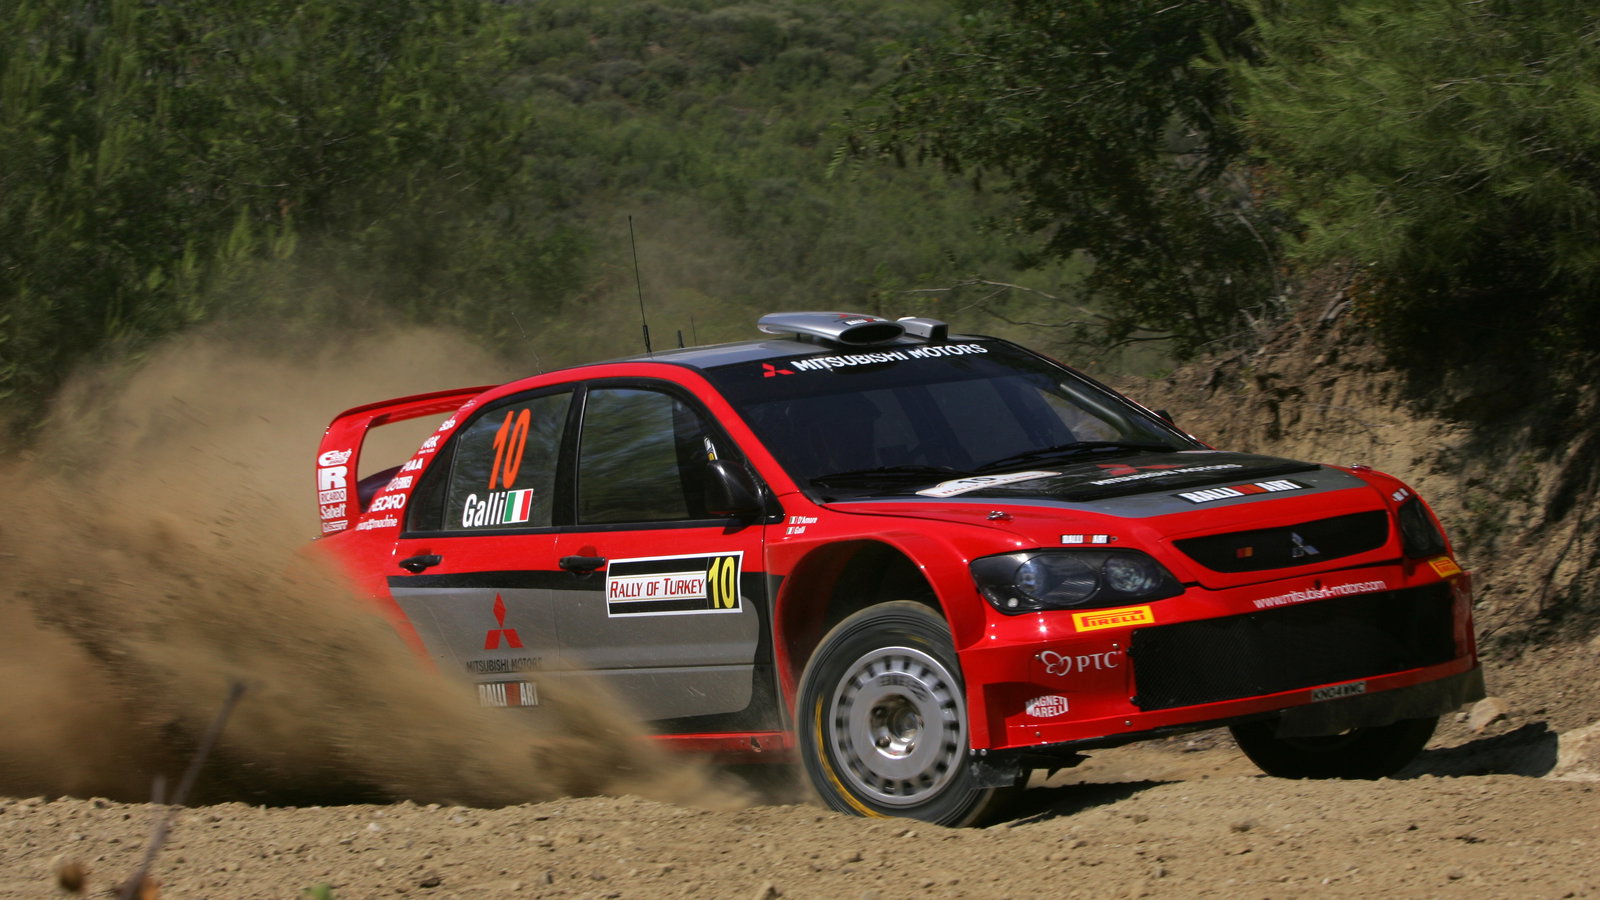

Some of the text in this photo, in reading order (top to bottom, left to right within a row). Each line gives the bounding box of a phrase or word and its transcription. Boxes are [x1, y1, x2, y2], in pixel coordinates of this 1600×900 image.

[790, 343, 988, 372] MITSUBISHI MOTORS
[488, 408, 531, 490] 10
[400, 458, 423, 473] PIAA
[1089, 463, 1243, 486] MITSUBISHI MOTORS
[318, 465, 348, 491] R
[320, 490, 346, 503] RICARDO
[320, 503, 347, 520] Sabelt
[462, 491, 506, 528] Galli
[609, 577, 705, 599] RALLY OF TURKEY
[708, 556, 735, 609] 10
[1079, 609, 1147, 628] PIRELLI
[466, 659, 510, 673] MITSUBISHI
[1075, 650, 1120, 673] PTC
